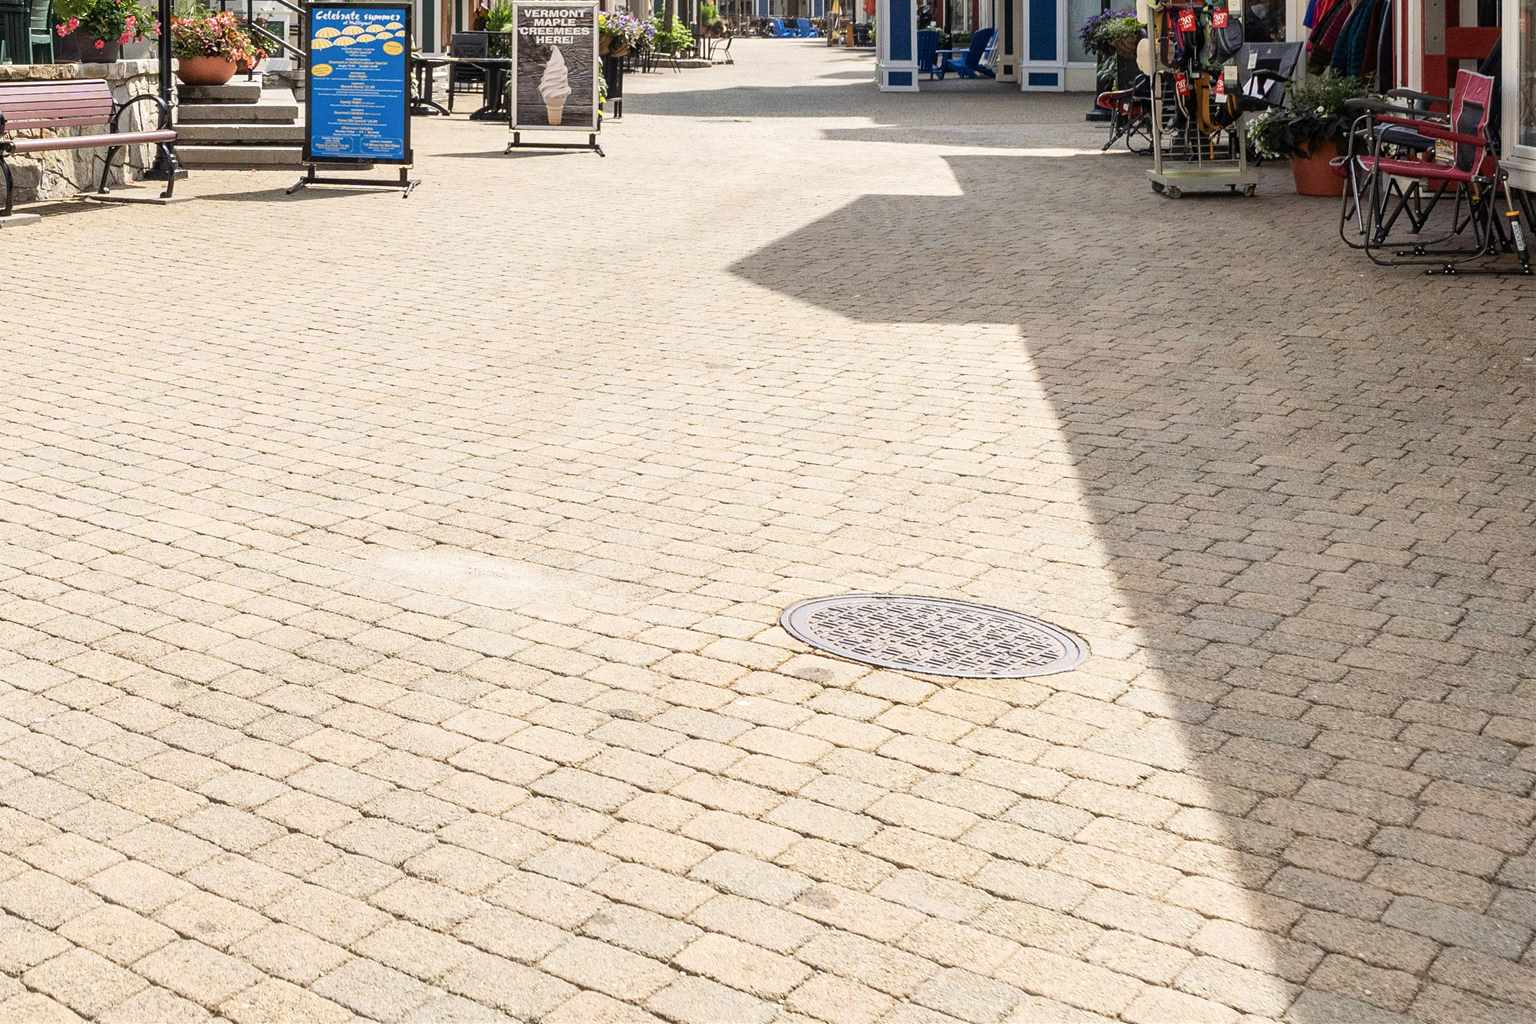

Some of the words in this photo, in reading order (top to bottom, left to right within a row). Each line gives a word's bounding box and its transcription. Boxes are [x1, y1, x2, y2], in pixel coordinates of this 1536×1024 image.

[315, 10, 360, 21] Celebrate
[364, 13, 401, 22] summer
[524, 9, 585, 18] VERMONT
[533, 18, 577, 27] MAPLE
[519, 27, 590, 36] CREEMEES
[536, 36, 574, 44] HERE!
